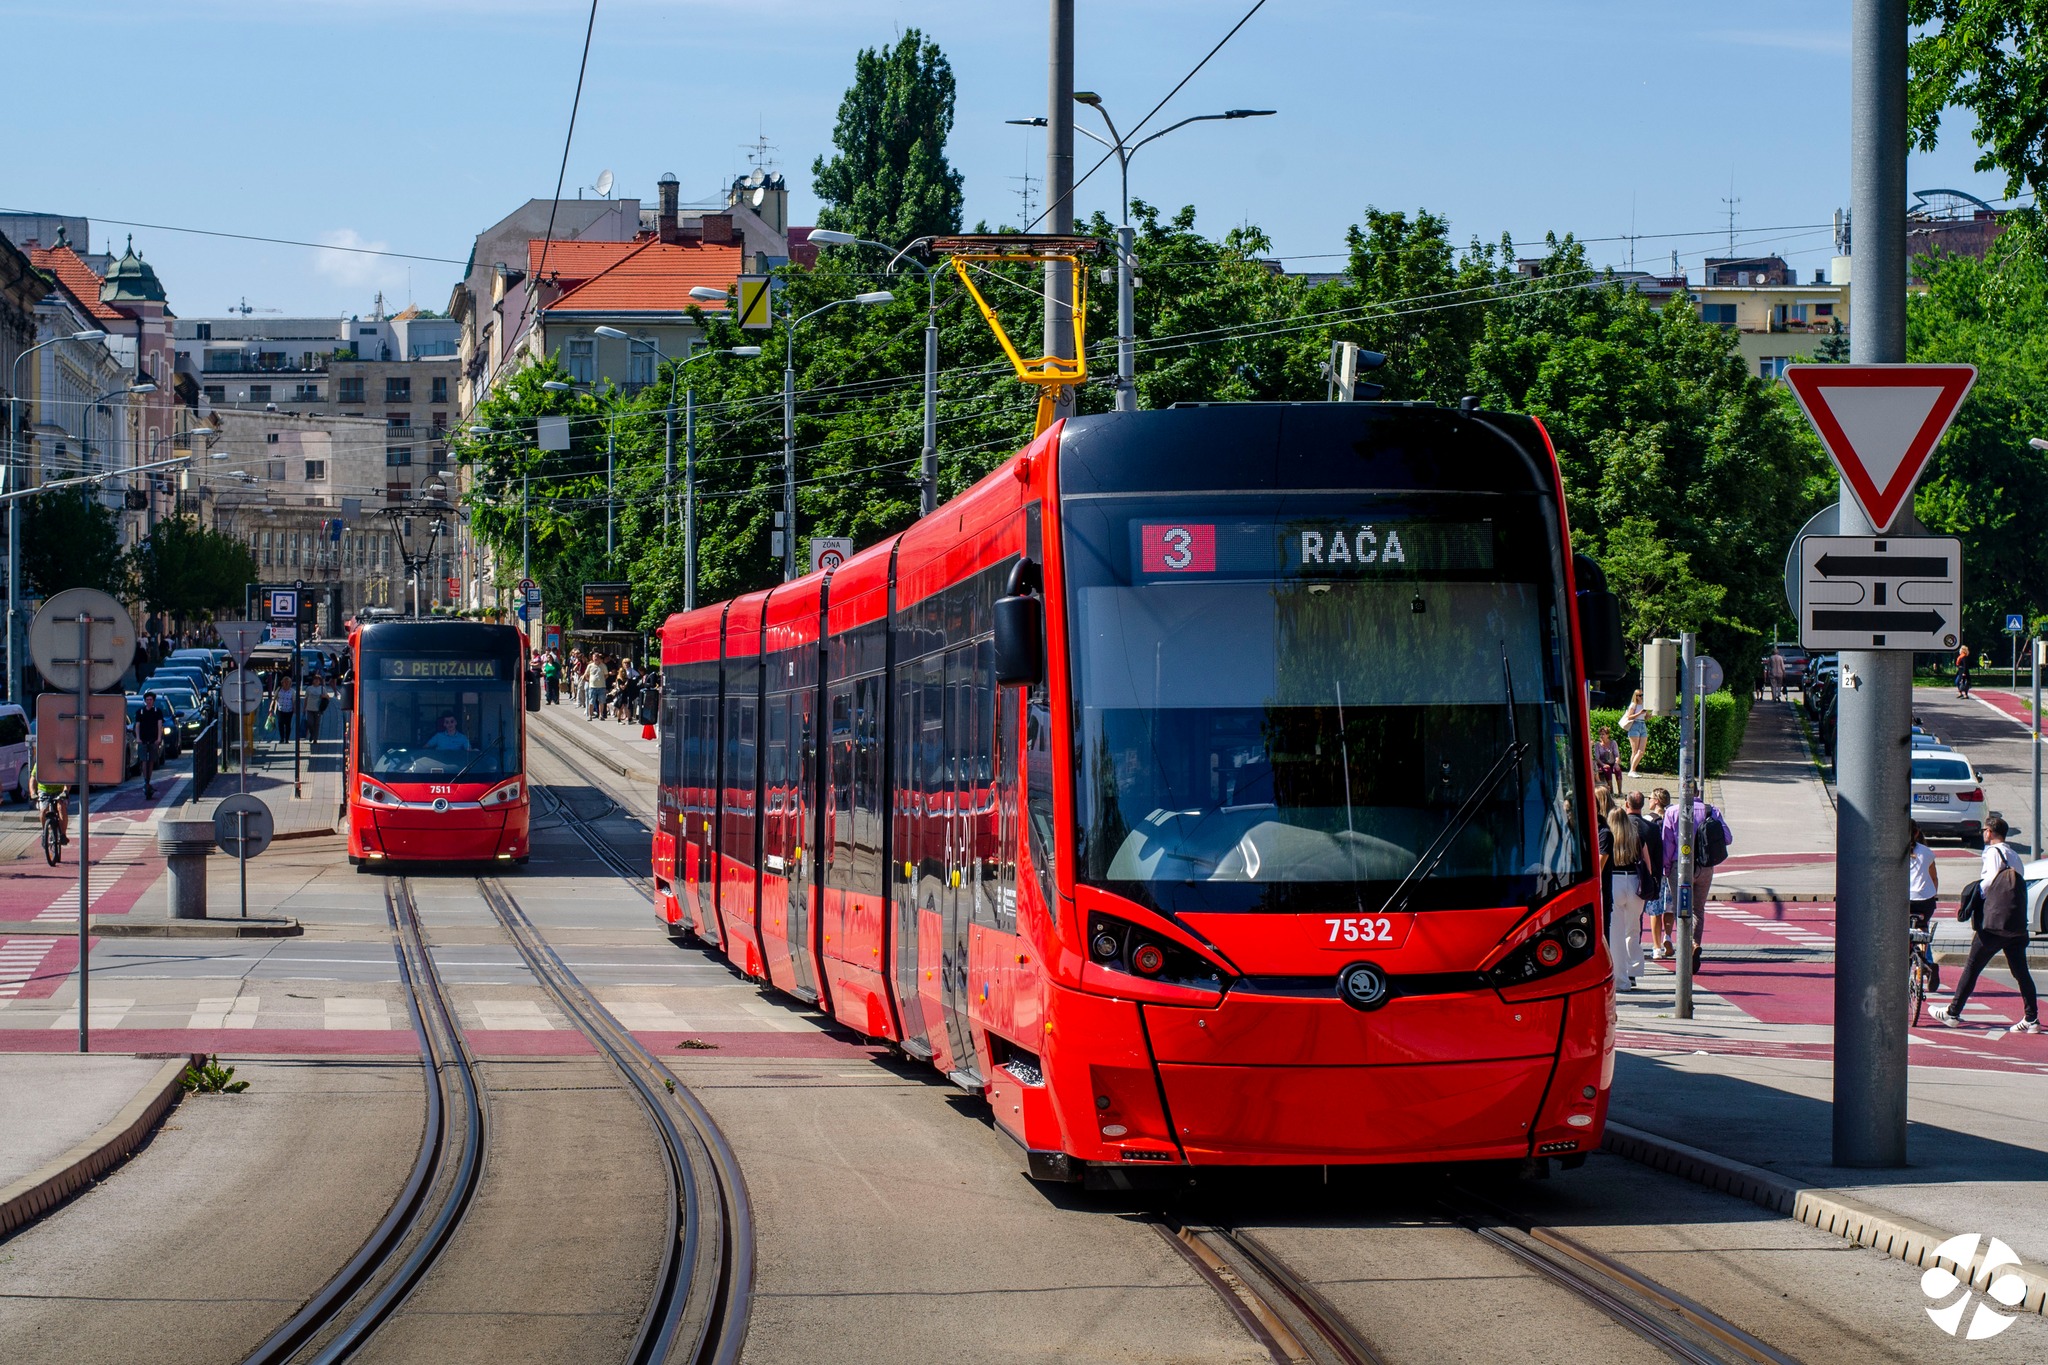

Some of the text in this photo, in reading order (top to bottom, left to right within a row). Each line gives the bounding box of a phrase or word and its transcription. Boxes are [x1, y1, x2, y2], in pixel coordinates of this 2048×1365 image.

[822, 540, 841, 549] ZÓNA
[1163, 525, 1406, 568] 3 RAČA
[824, 556, 840, 569] 30
[296, 581, 302, 589] B
[393, 660, 494, 677] 3 PETRŽALKA
[430, 785, 451, 794] 7511
[1325, 917, 1394, 942] 7532
